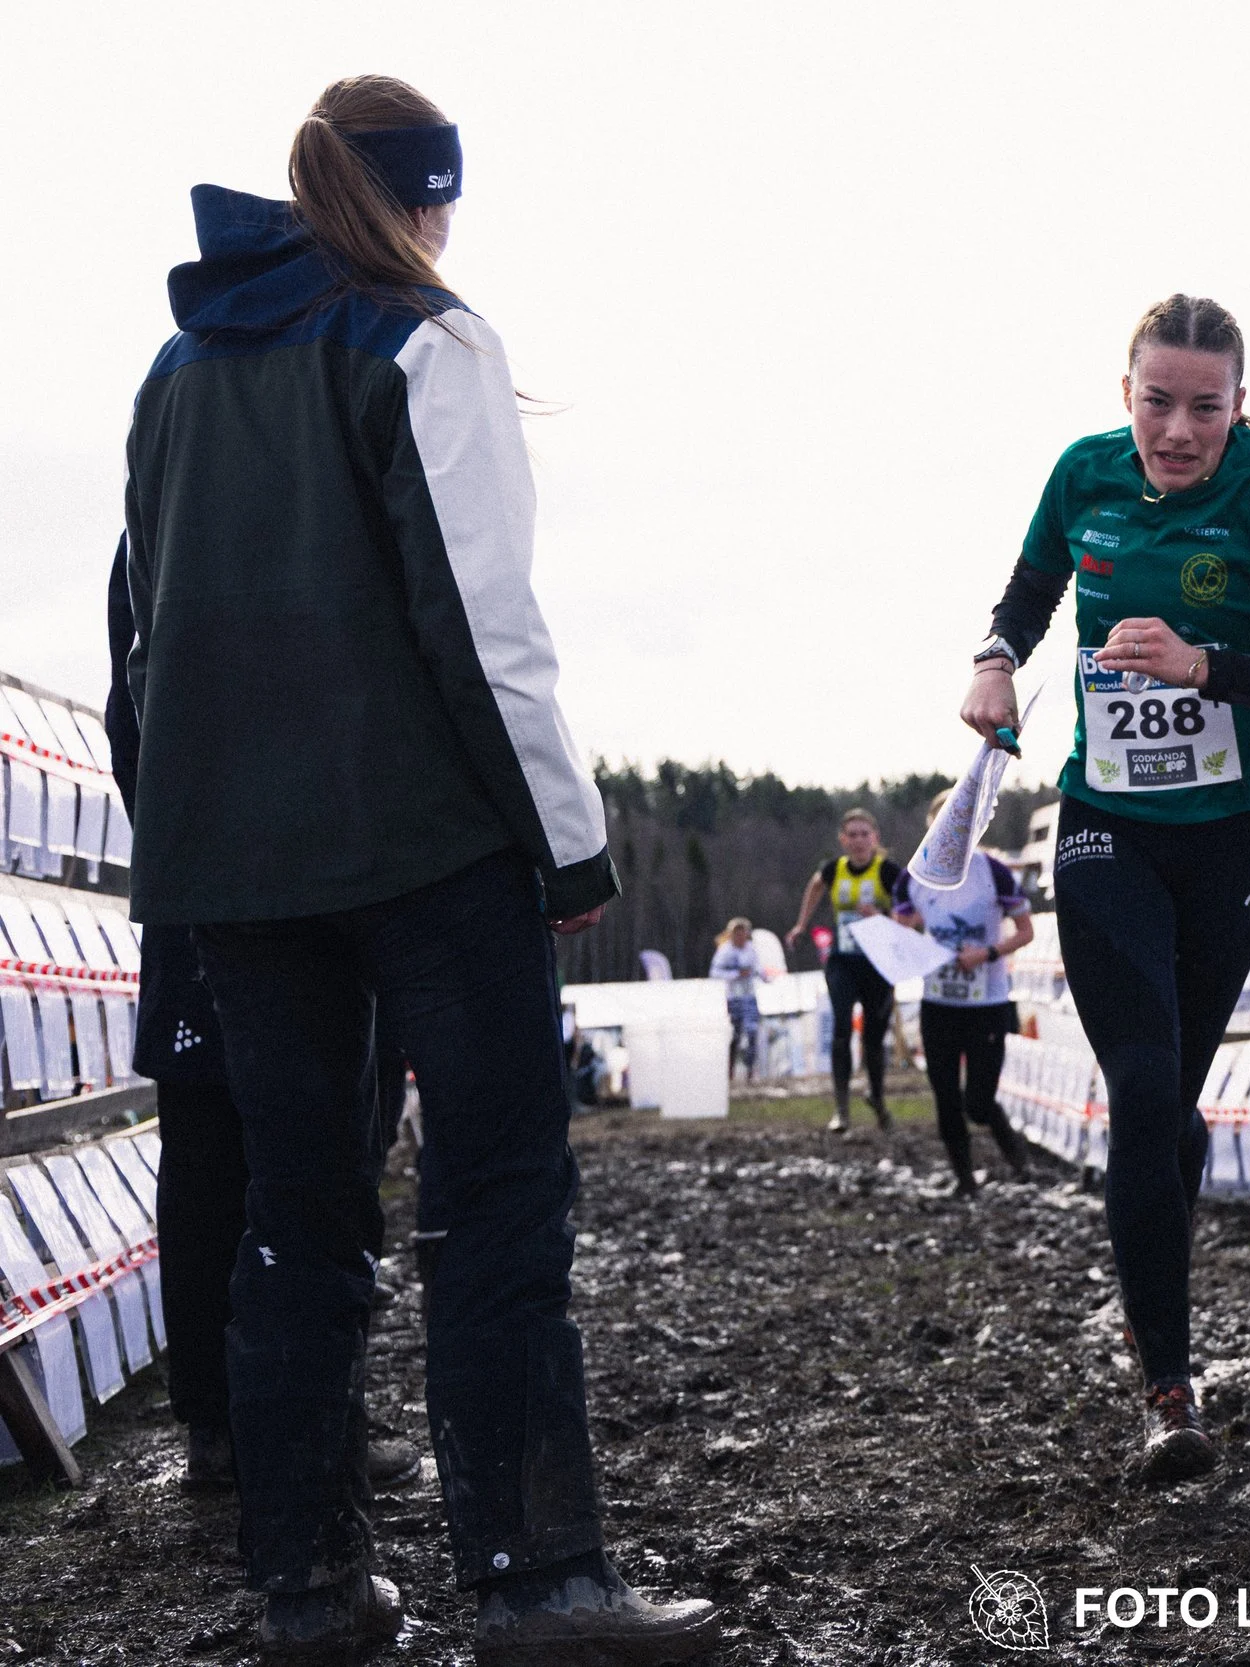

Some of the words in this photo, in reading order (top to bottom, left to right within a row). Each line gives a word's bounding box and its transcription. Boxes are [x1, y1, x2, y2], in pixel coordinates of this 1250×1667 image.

[1107, 697, 1206, 740] 288
[1131, 751, 1188, 763] GODKÄNDA
[1058, 829, 1113, 852] cadre
[1057, 843, 1114, 865] romand
